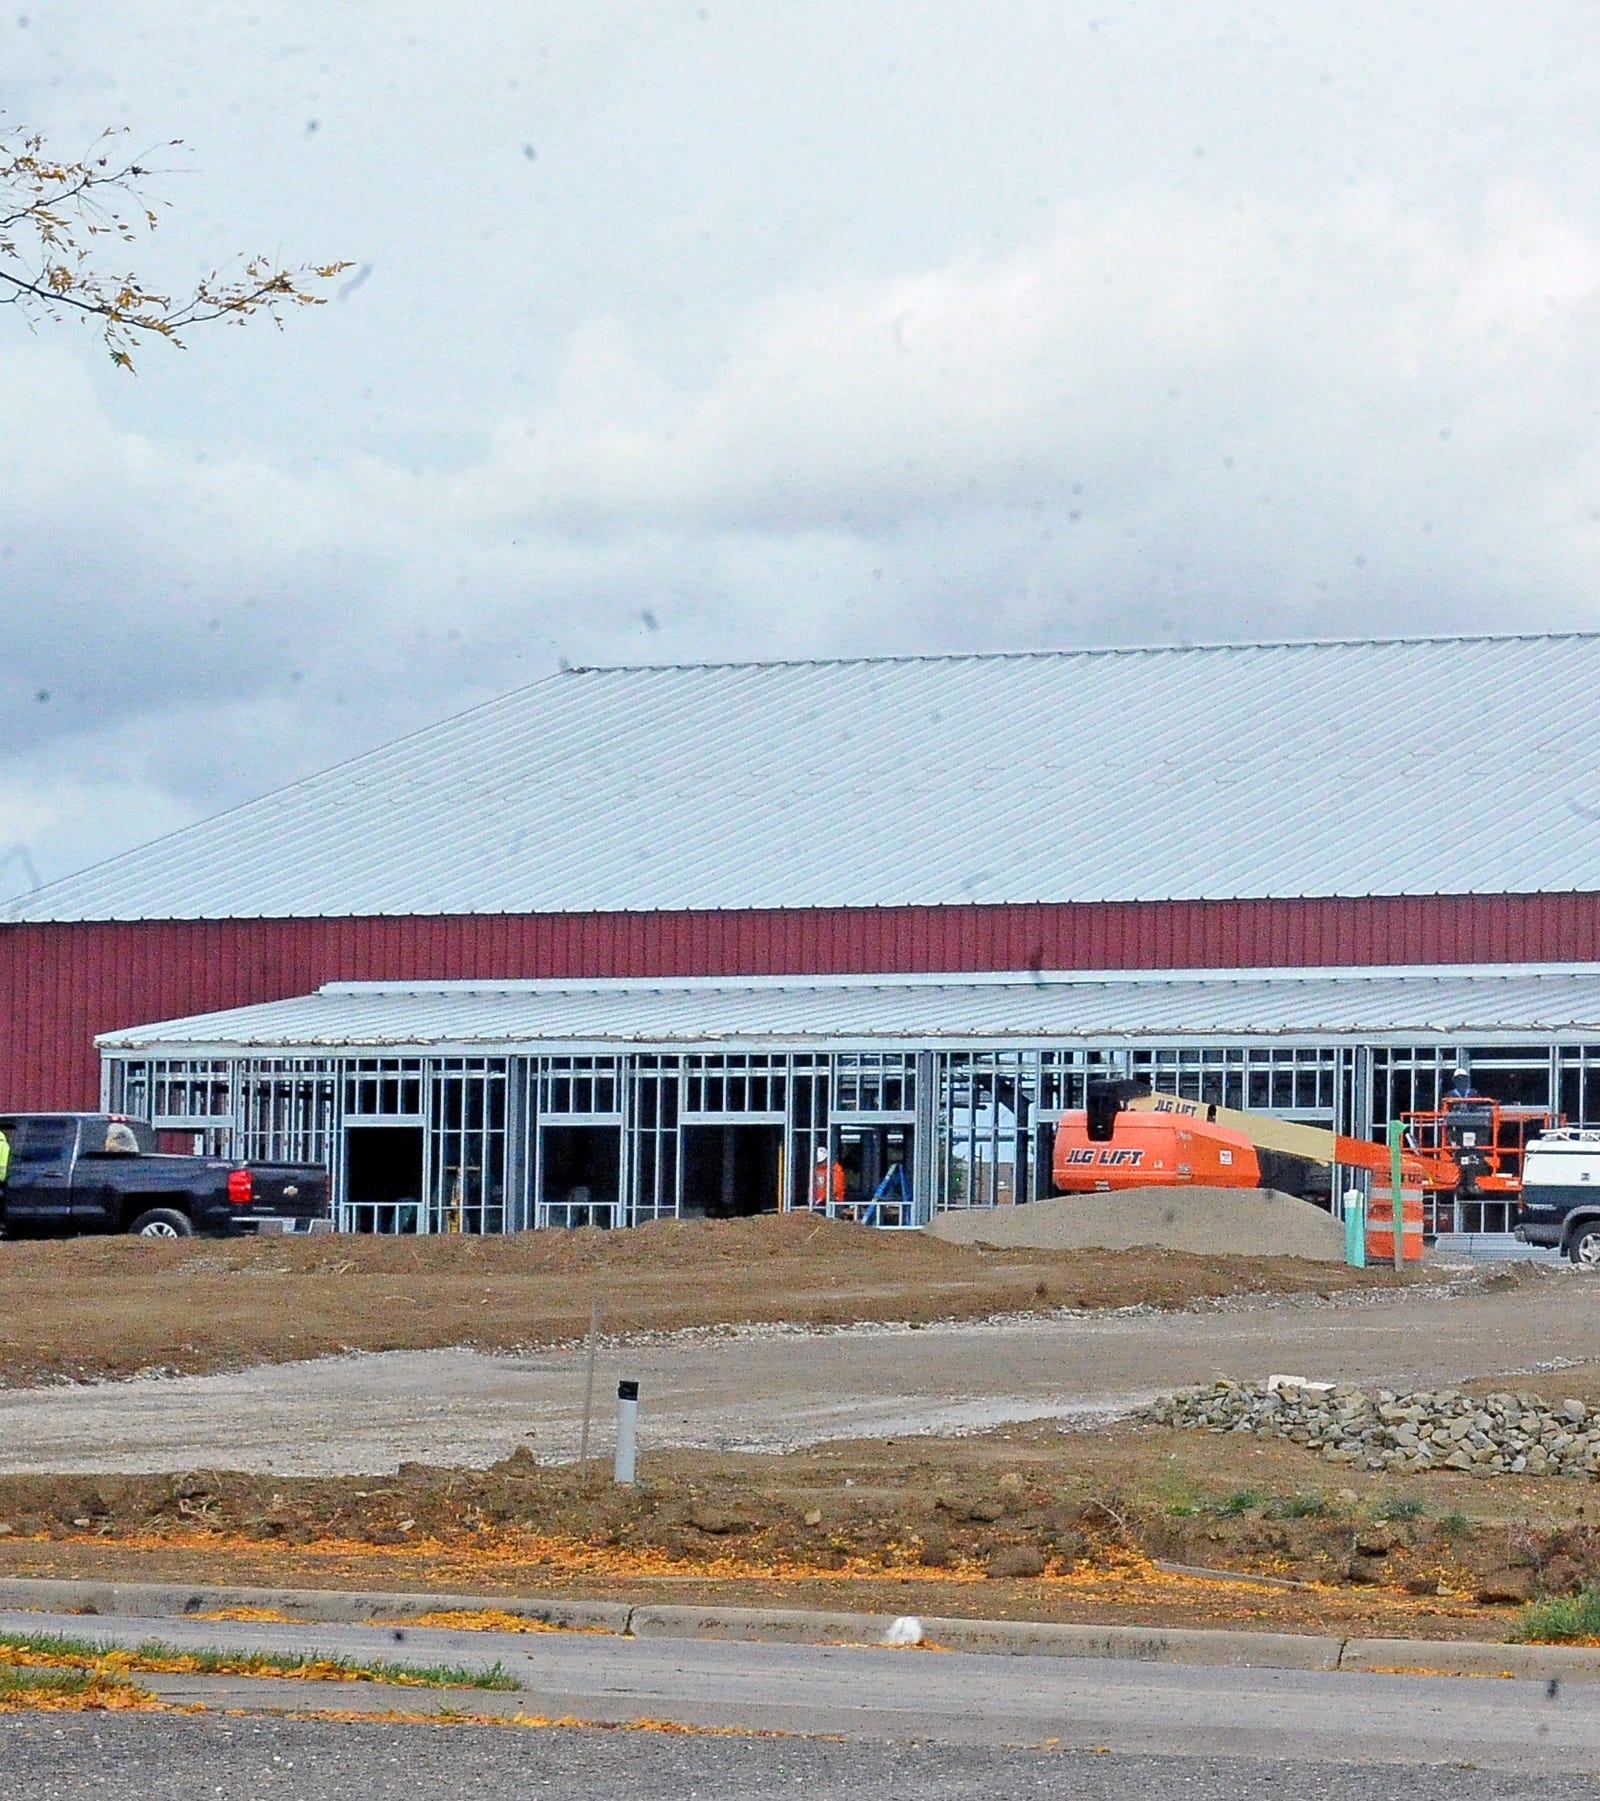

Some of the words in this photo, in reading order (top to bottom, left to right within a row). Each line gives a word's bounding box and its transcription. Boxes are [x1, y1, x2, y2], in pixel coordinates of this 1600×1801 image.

[1154, 1099, 1173, 1112] JLG
[1175, 1102, 1198, 1117] LIFT
[1066, 1148, 1095, 1165] JLG
[1098, 1148, 1145, 1166] LIFT
